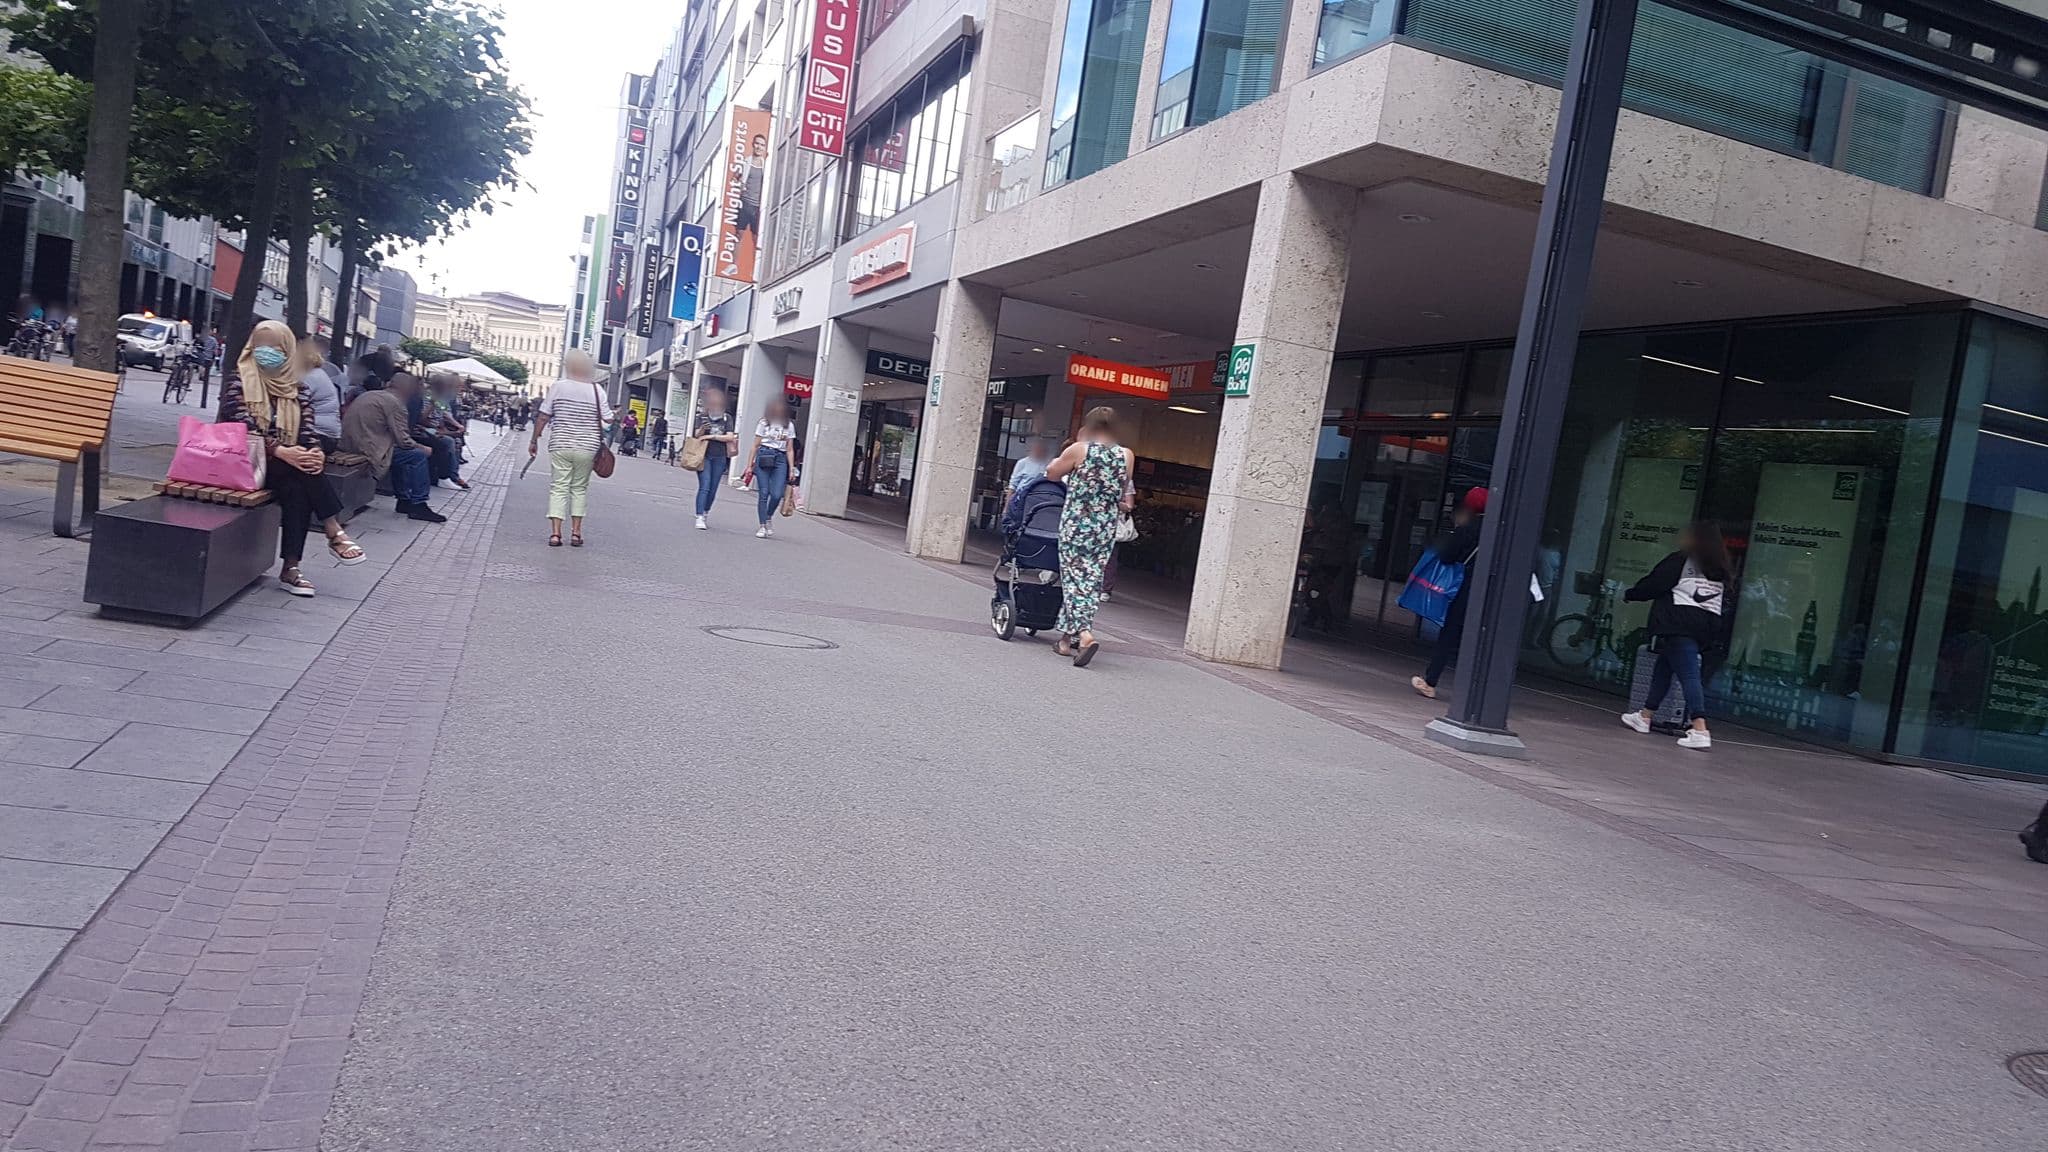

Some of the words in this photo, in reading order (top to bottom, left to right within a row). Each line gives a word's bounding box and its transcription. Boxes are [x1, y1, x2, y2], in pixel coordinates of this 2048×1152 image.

[814, 85, 841, 98] RADIO
[730, 120, 748, 174] Sports
[811, 130, 834, 149] TV
[624, 148, 641, 201] KINO
[724, 178, 743, 225] Night
[720, 232, 739, 263] Day
[1070, 363, 1116, 383] ORANJE
[1121, 372, 1169, 393] BLUMEN
[1227, 376, 1247, 390] Bank
[1753, 533, 1777, 544] Mein
[1755, 521, 1779, 532] Mein
